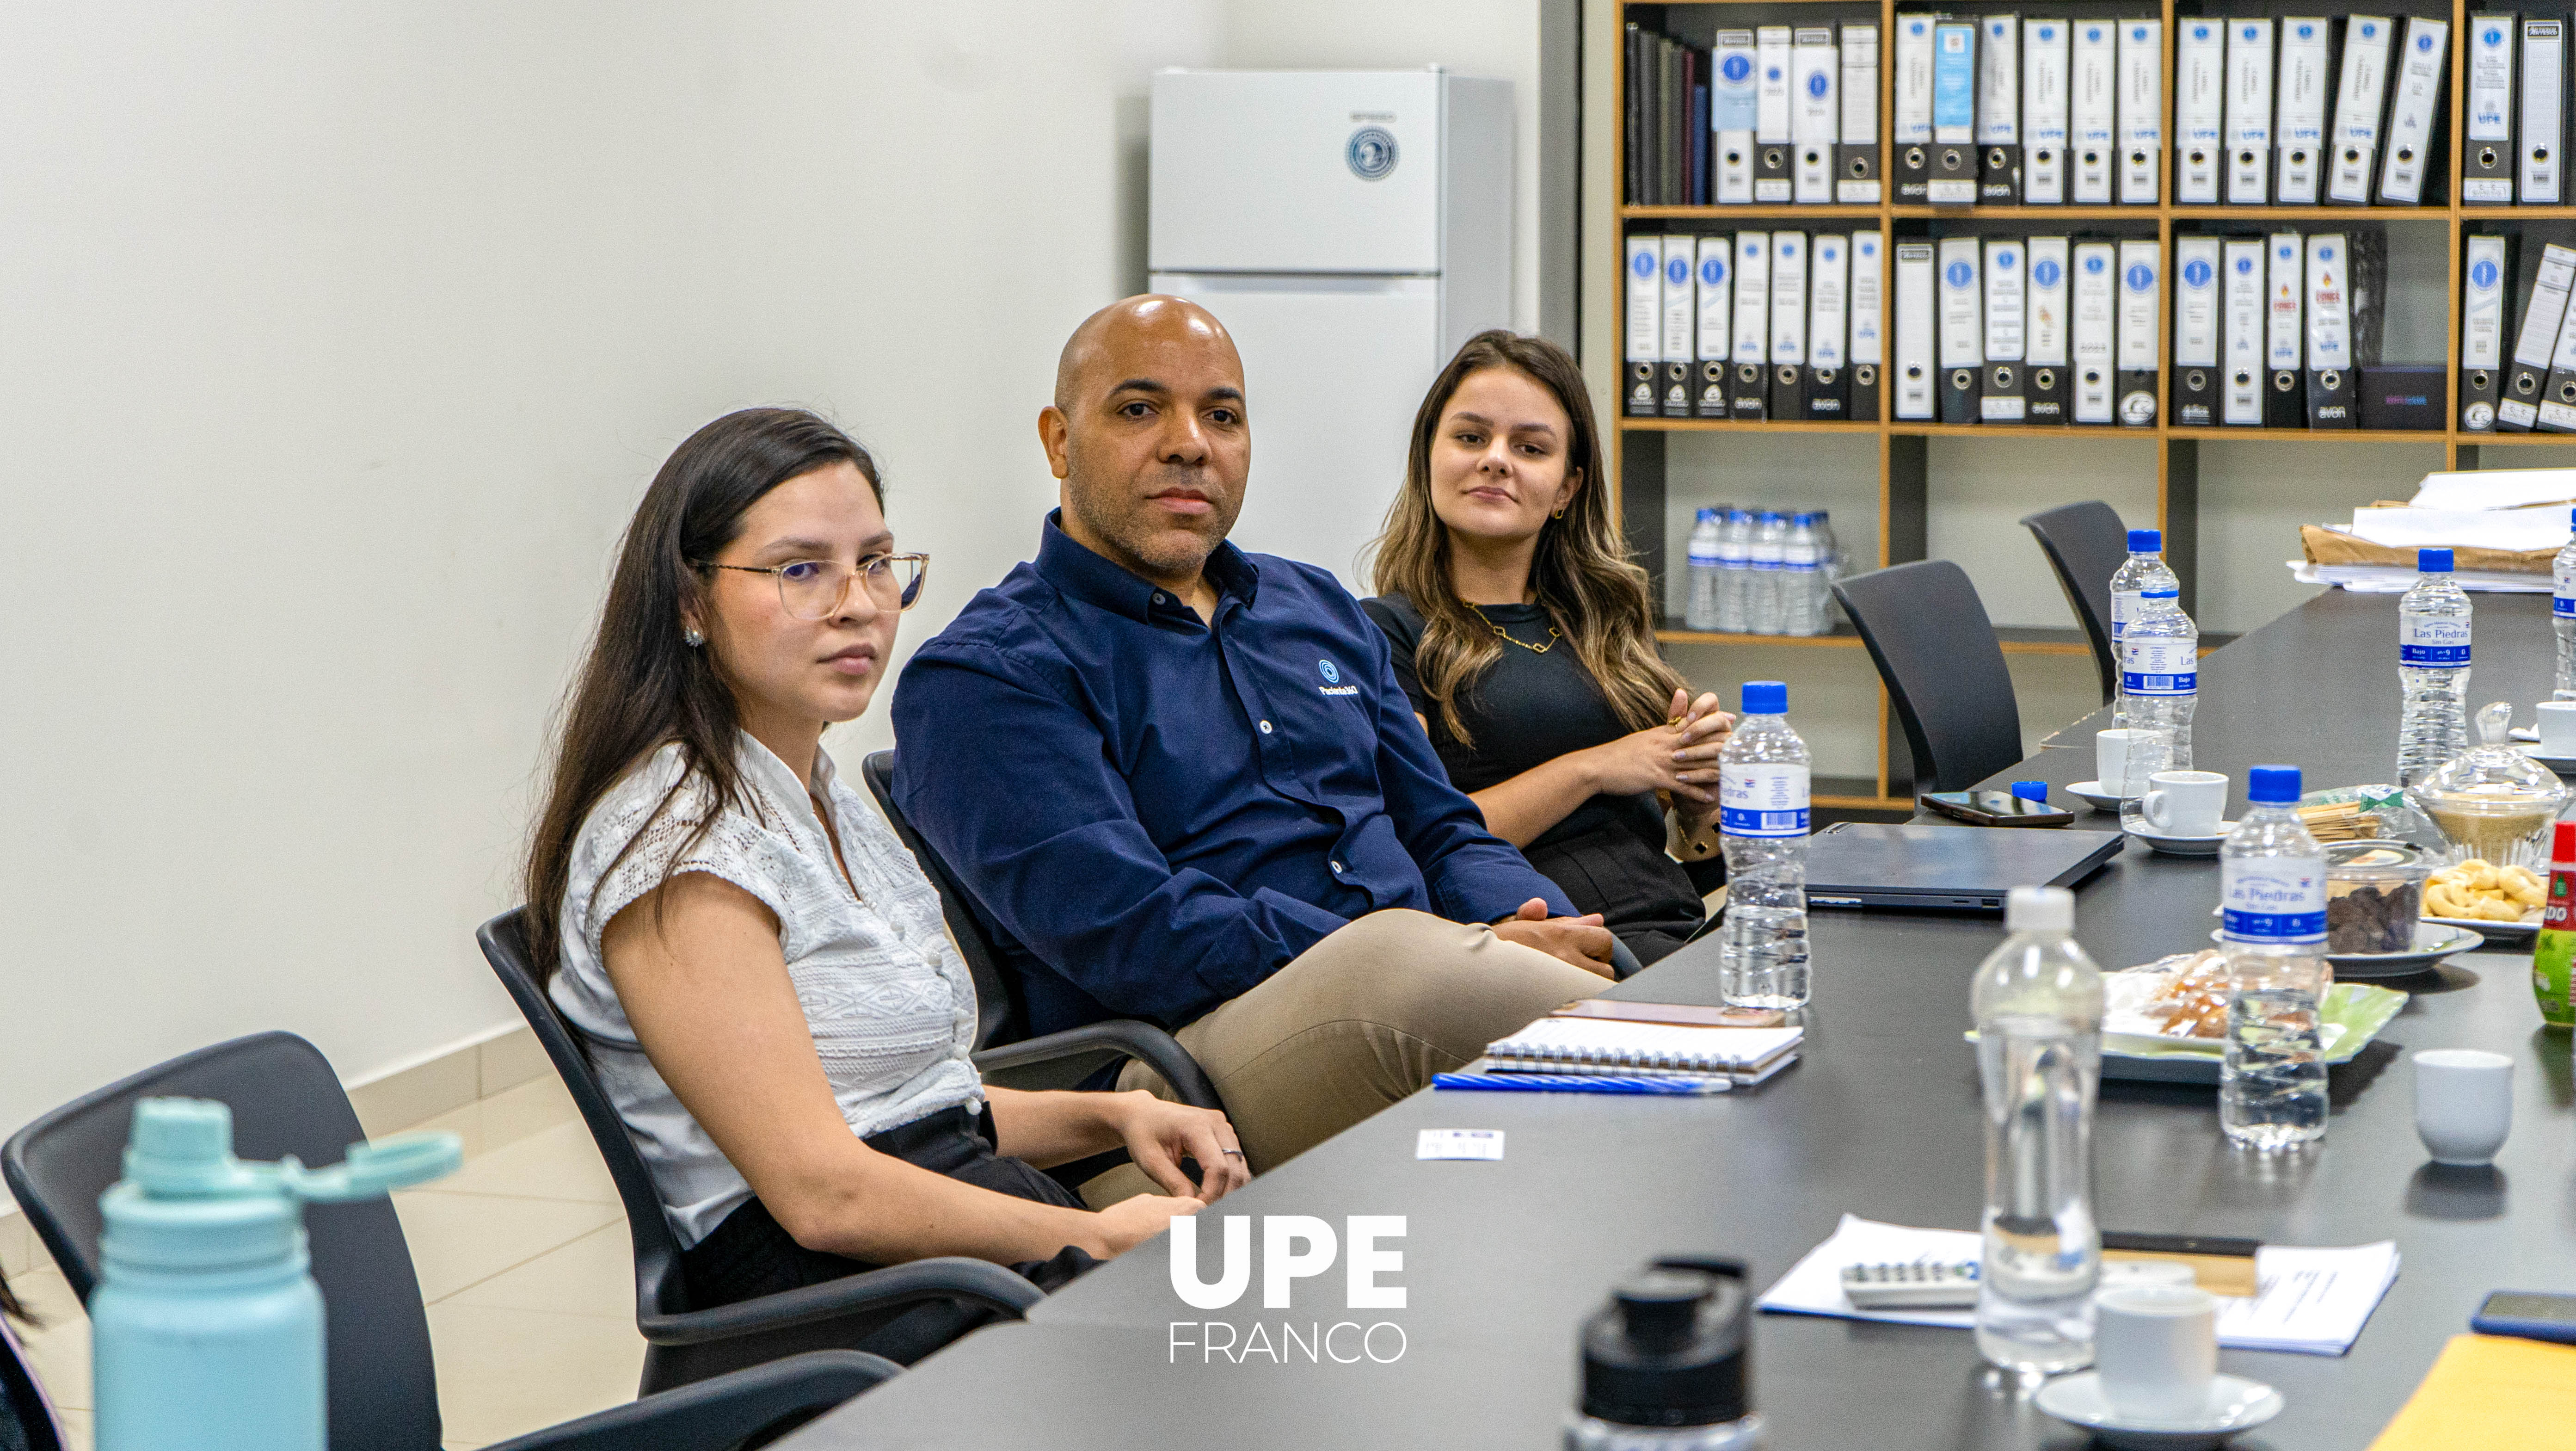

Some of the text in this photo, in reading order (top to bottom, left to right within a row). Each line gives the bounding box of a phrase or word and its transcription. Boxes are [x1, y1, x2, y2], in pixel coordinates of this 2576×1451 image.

[1983, 184, 2010, 197] avon
[2318, 406, 2346, 419] avon
[2414, 628, 2468, 638] Las Piedras
[2181, 656, 2194, 665] Las
[2250, 887, 2305, 902] Piedras
